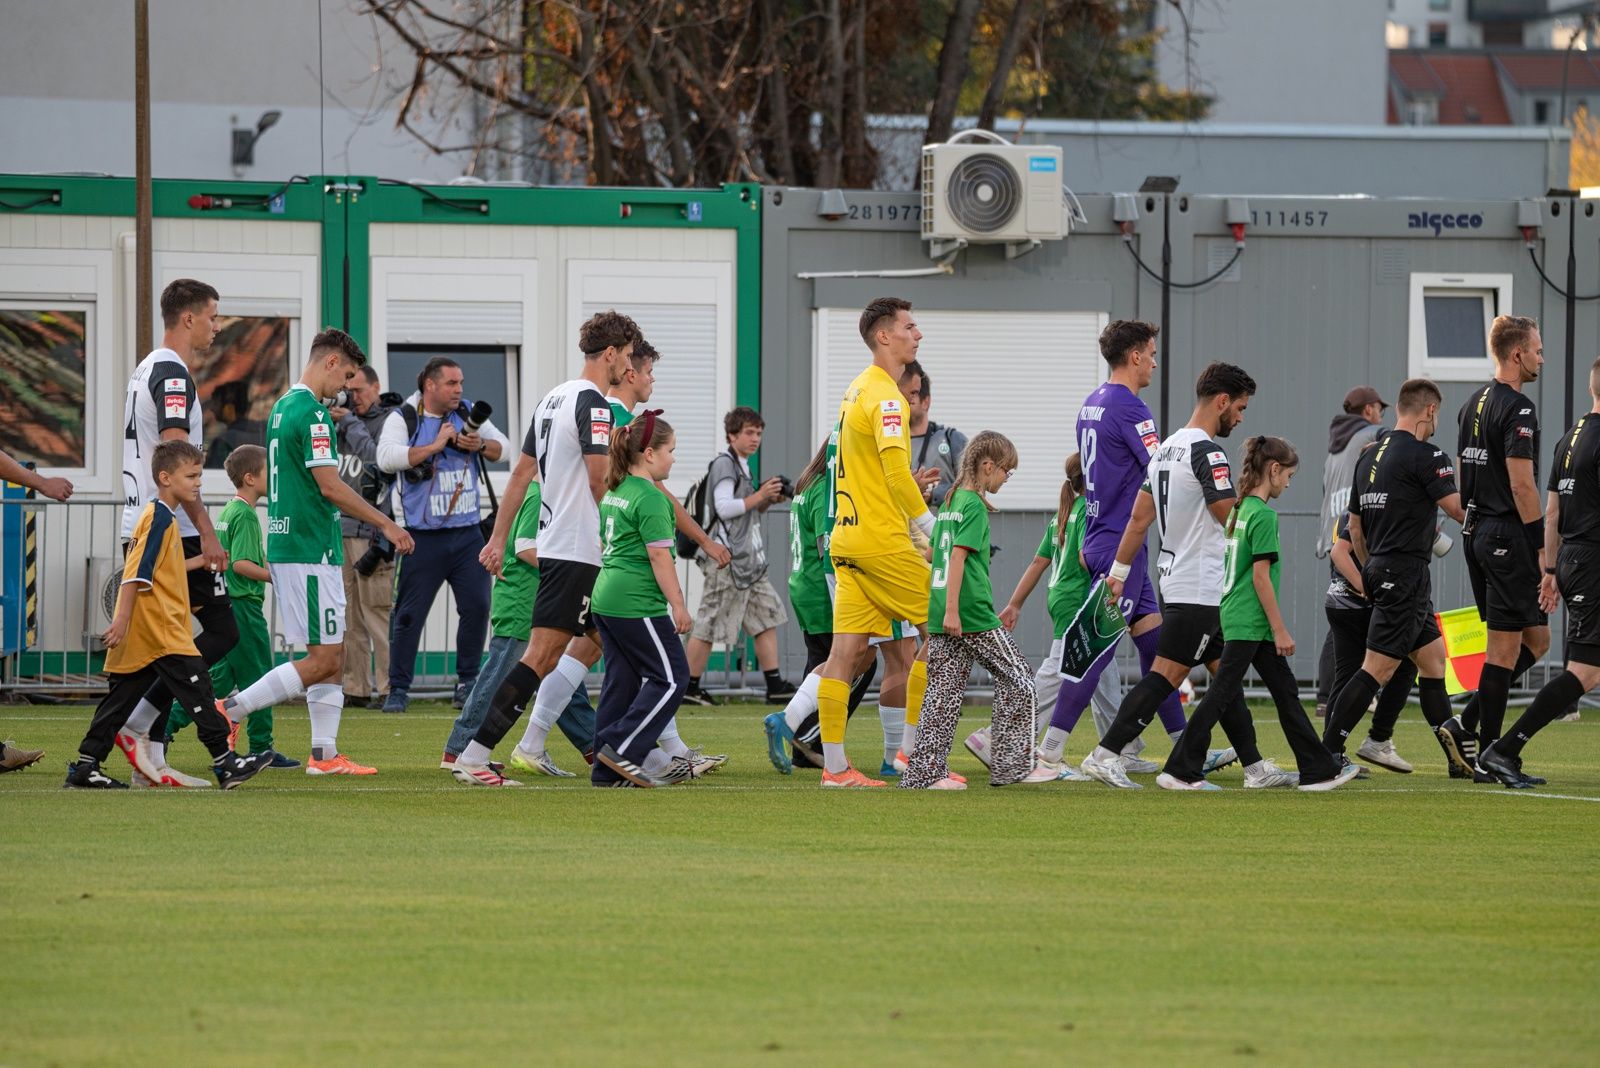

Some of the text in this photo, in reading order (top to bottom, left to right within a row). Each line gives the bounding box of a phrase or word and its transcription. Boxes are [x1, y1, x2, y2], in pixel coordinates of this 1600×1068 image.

[1251, 211, 1328, 226] 111457
[1408, 211, 1483, 237] algeco
[325, 608, 337, 636] 6
